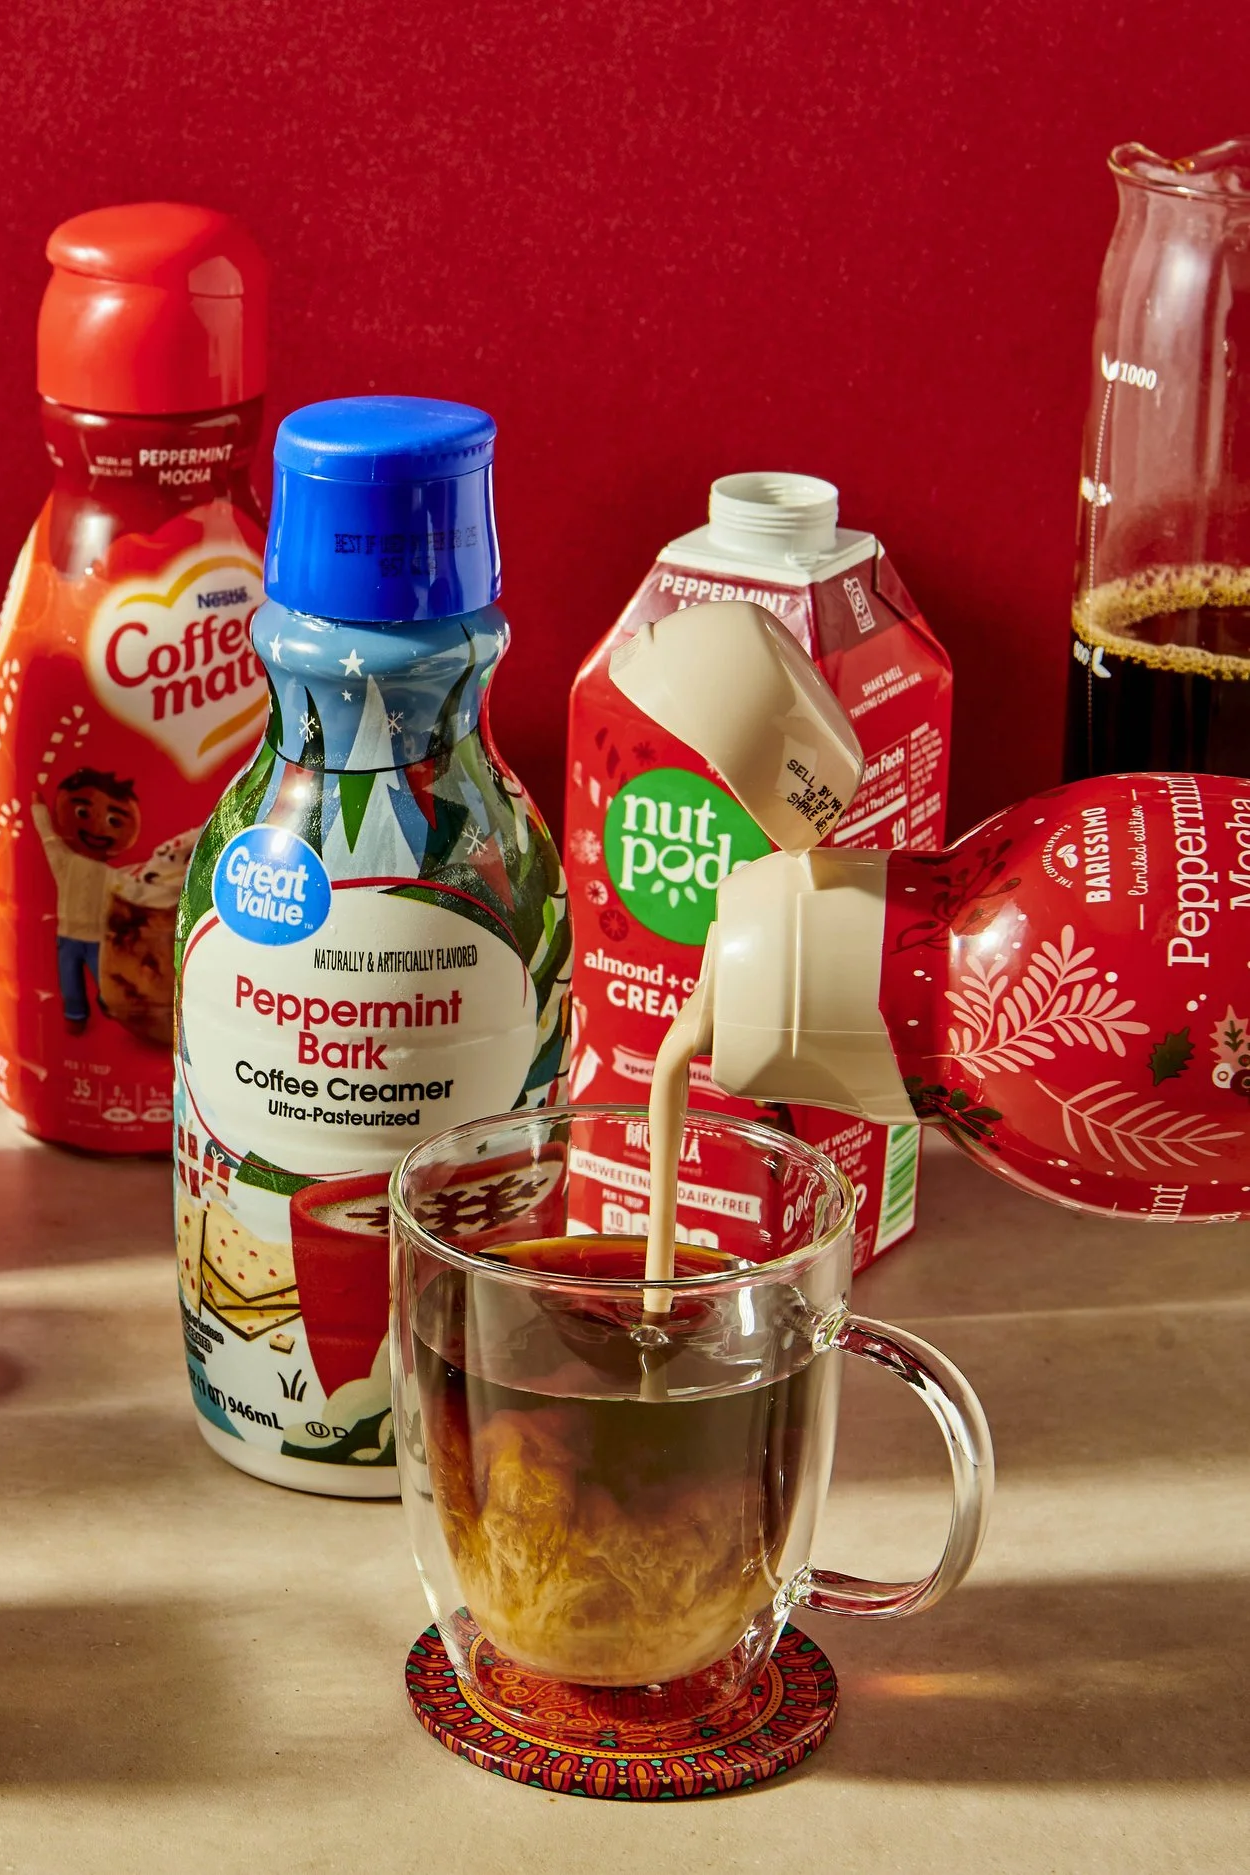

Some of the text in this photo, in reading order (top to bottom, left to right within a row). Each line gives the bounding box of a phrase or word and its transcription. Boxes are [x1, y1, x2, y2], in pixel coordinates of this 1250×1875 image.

[1119, 362, 1158, 390] 1000
[138, 443, 233, 467] PEPPERMINT
[158, 467, 211, 485] MOCHA
[334, 532, 363, 554] BEST
[658, 574, 792, 614] PEPPERMINT
[861, 665, 903, 697] SHAKE WELL
[849, 697, 878, 720] TWISTING
[880, 746, 905, 775] Facts
[786, 759, 815, 788] SELL
[818, 785, 833, 800] BY
[621, 793, 718, 848] nut
[787, 792, 819, 822] SHAKE
[892, 817, 906, 846] 10
[1042, 824, 1073, 889] THE COFFEE EXPERTS
[1081, 807, 1111, 903] BARISSIMO
[1127, 805, 1149, 896] limited edition
[226, 846, 309, 902] Great
[1158, 776, 1220, 968] Peppermint
[235, 885, 304, 926] Value
[313, 944, 478, 973] NATURALLY & ARTIFICIALLY FLAVORED
[583, 948, 665, 986] almond
[235, 974, 463, 1030] Peppermint
[298, 1031, 389, 1070] Bark
[73, 1077, 91, 1098] 35
[234, 1060, 454, 1103] Coffee Creamer
[267, 1099, 421, 1127] Ultra-Pasteurized
[831, 1120, 865, 1147] WOULD
[839, 1144, 851, 1158] TO
[850, 1130, 873, 1153] HEAR
[602, 1188, 617, 1201] PER
[677, 1188, 752, 1215] DAIRY-FREE
[609, 1210, 624, 1226] 10
[207, 1383, 227, 1412] QT)
[228, 1396, 285, 1431] 946mL
